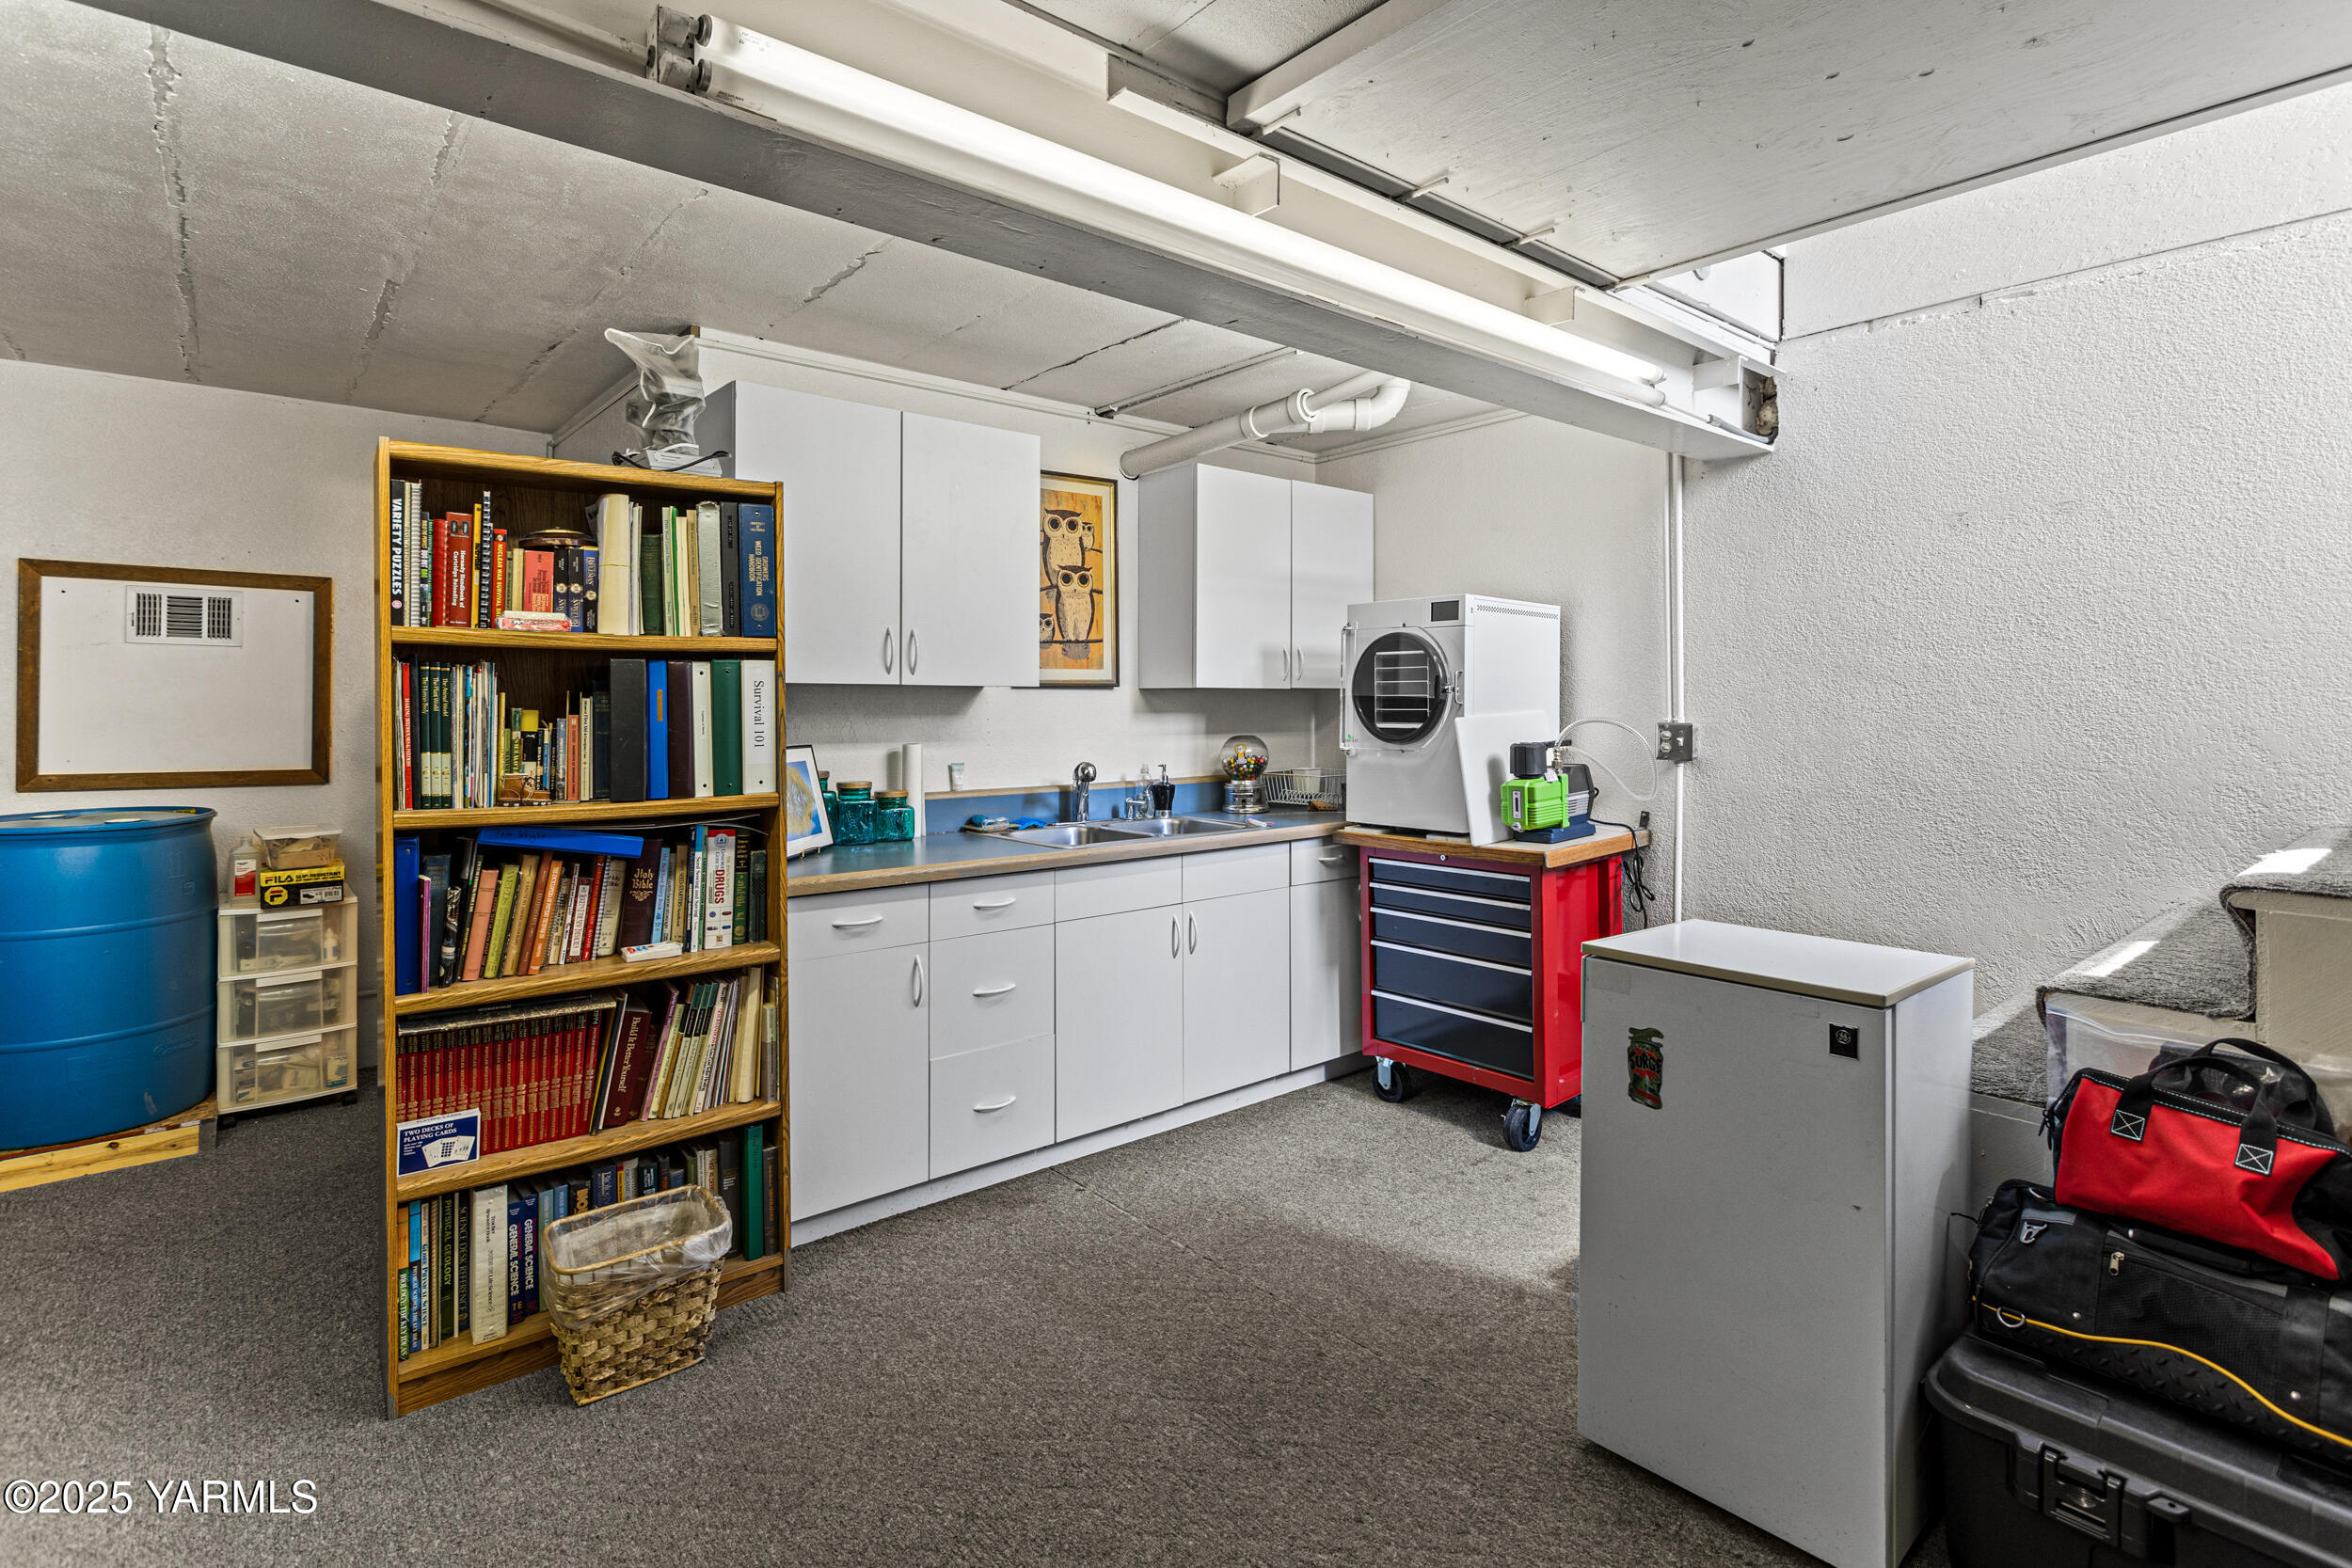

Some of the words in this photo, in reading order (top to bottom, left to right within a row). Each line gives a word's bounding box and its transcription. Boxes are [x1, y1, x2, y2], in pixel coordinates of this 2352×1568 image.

[391, 498, 403, 545] VARIETY
[391, 546, 404, 594] PUZZLES
[451, 550, 459, 578] Cartridge
[458, 549, 467, 573] Hornady
[451, 578, 459, 607] Reloading
[754, 680, 765, 725] Survival
[754, 730, 765, 748] 101
[265, 875, 294, 885] FILA
[295, 871, 342, 879] SLIP-RESISTANT
[632, 878, 654, 890] Bible
[634, 867, 655, 880] Holy
[714, 869, 725, 904] DRUGS
[629, 1016, 642, 1036] Build
[623, 1043, 636, 1065] Better
[1629, 1053, 1662, 1073] SURGE
[616, 1064, 631, 1093] Yourself
[403, 1132, 434, 1143] PLAYING
[435, 1128, 457, 1137] CARDS
[421, 1125, 444, 1133] DECKS
[444, 1199, 453, 1242] PHYSICAL
[458, 1206, 468, 1239] SCIENCE
[509, 1224, 517, 1260] GENERAL
[524, 1219, 533, 1255] GENERAL
[443, 1243, 452, 1285] GEOLOGY
[458, 1242, 468, 1261] DESK
[421, 1267, 429, 1297] PHYSICAL
[509, 1261, 518, 1296] SCIENCE
[524, 1255, 533, 1290] SCIENCE
[458, 1266, 468, 1310] REFERENCE
[399, 1307, 408, 1321] THE
[399, 1322, 408, 1335] KEY
[399, 1336, 408, 1356] IDEAS
